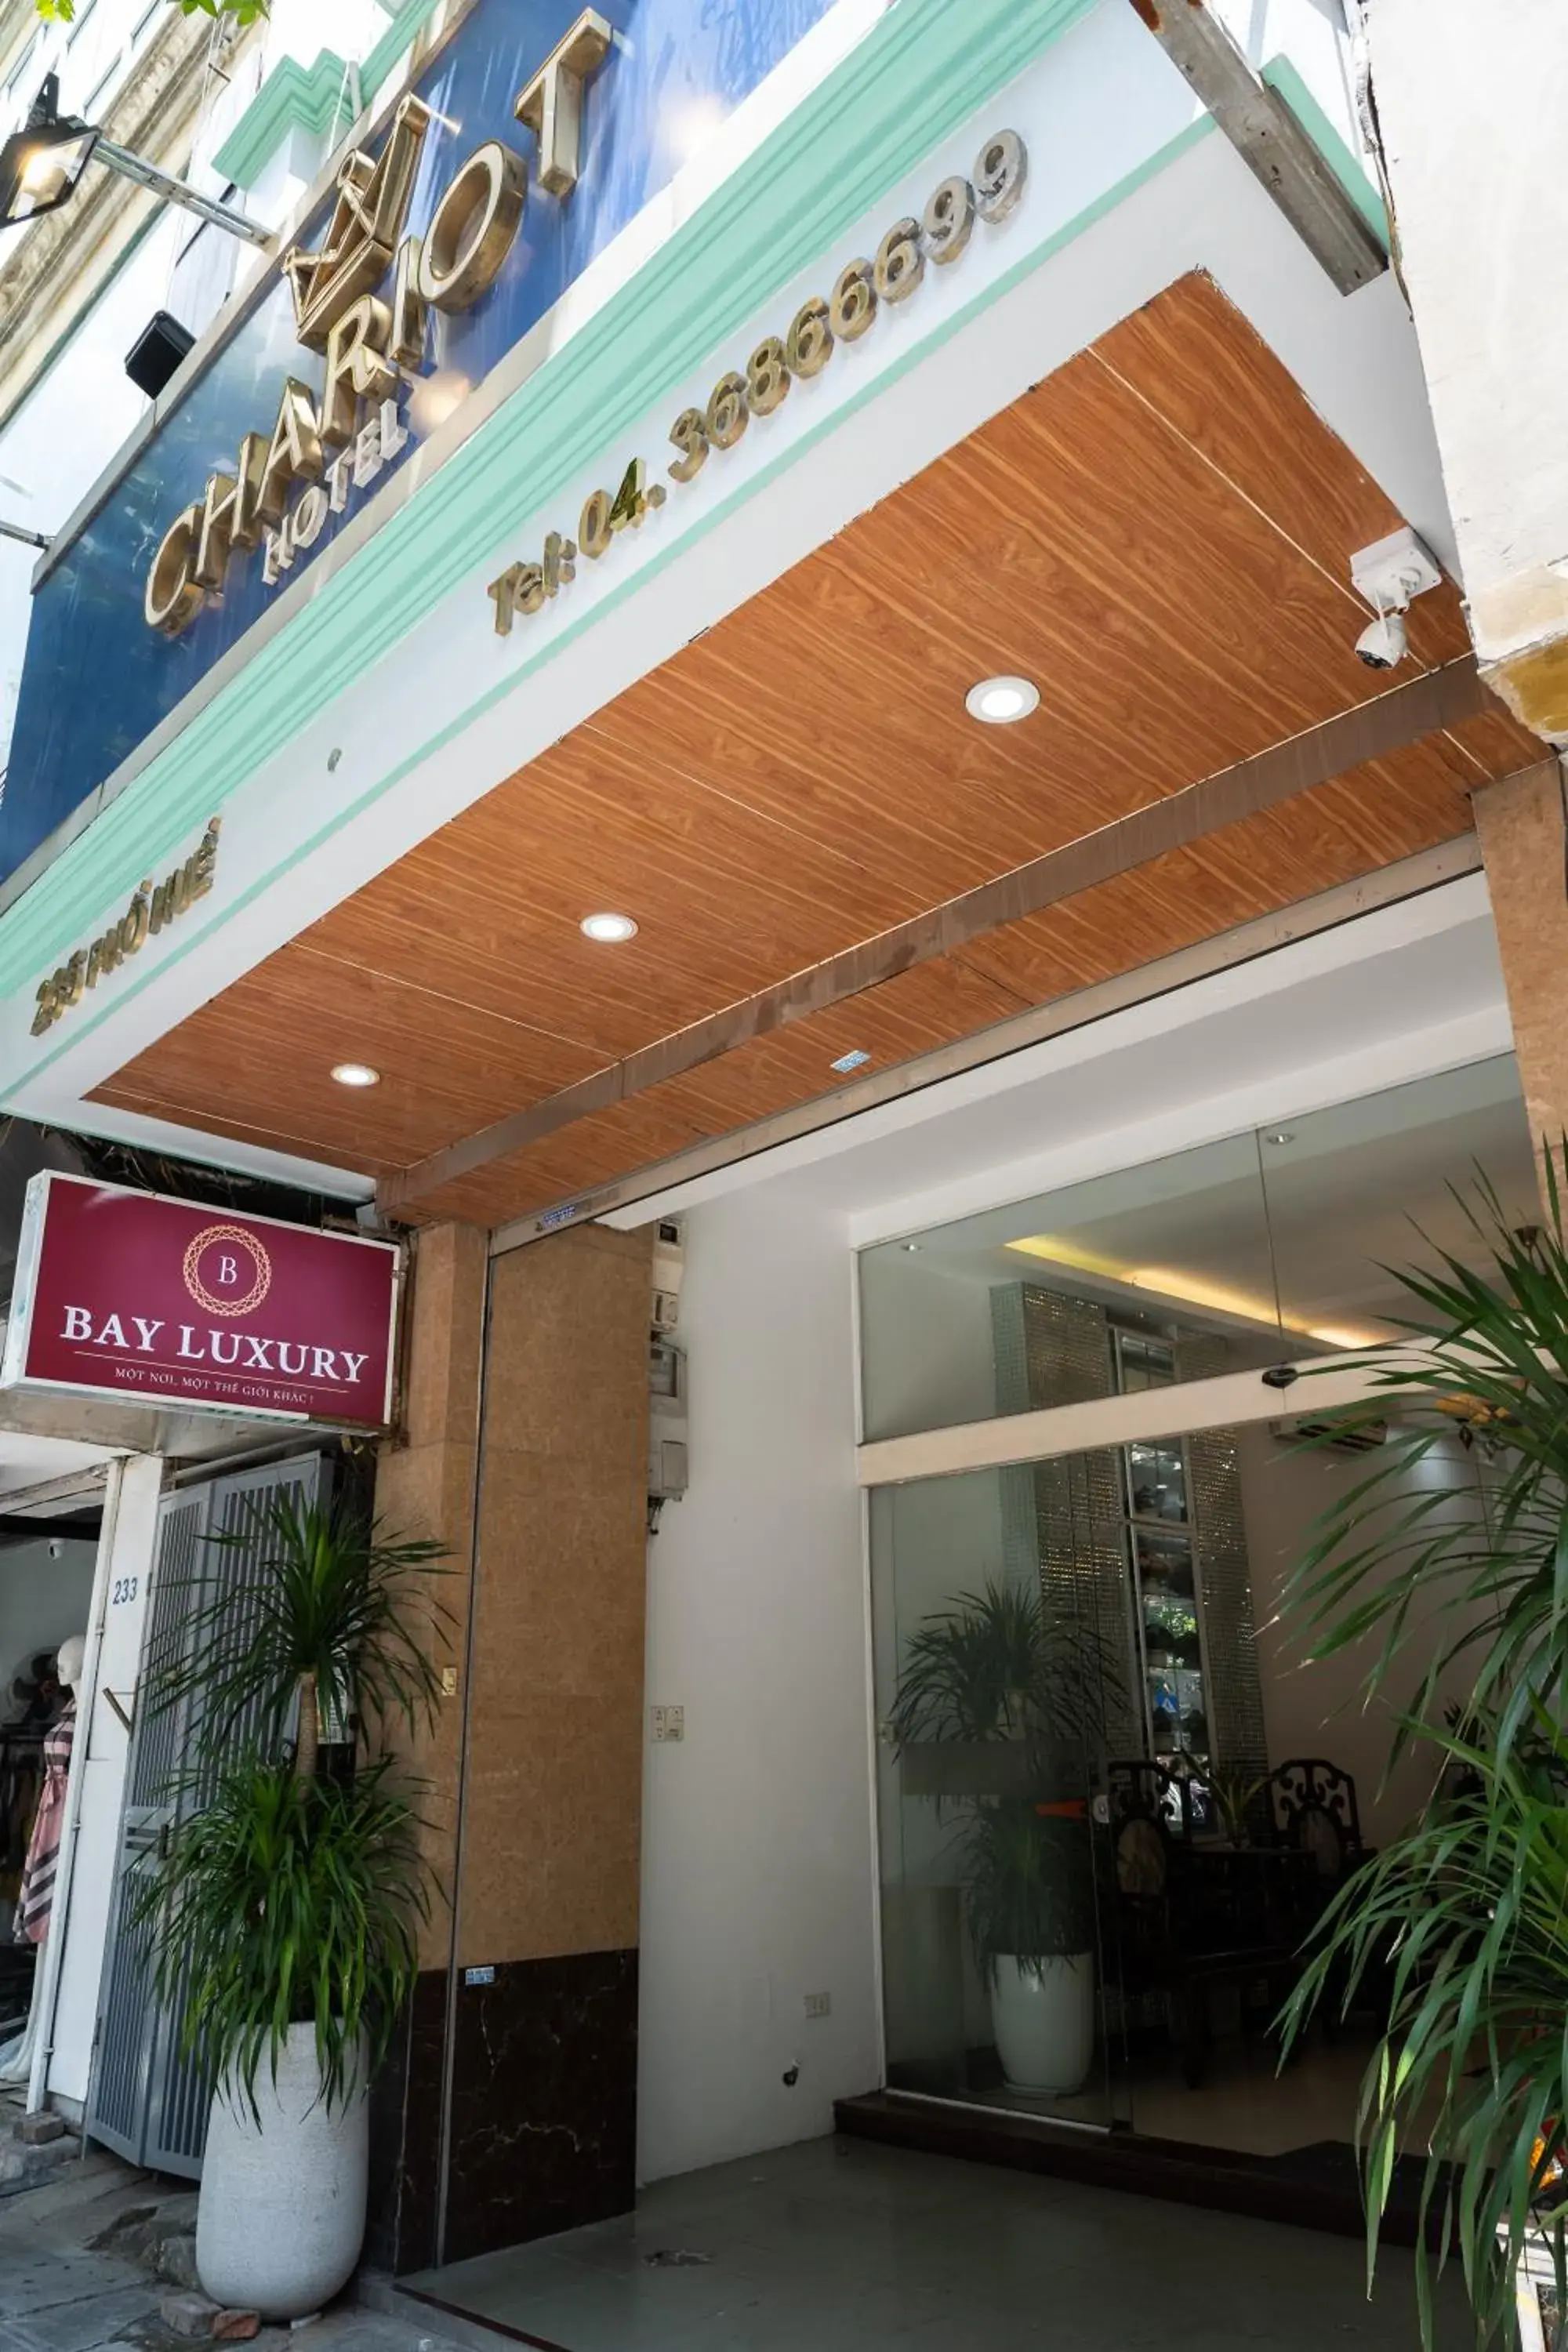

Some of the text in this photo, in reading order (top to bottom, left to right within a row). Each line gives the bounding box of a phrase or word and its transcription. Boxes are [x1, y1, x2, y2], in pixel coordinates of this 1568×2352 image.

[143, 5, 612, 639] CHARIOT
[262, 398, 408, 586] HOTEL
[218, 1256, 238, 1284] B
[60, 1305, 370, 1383] BAY LUXURY
[112, 1577, 138, 1605] 233
